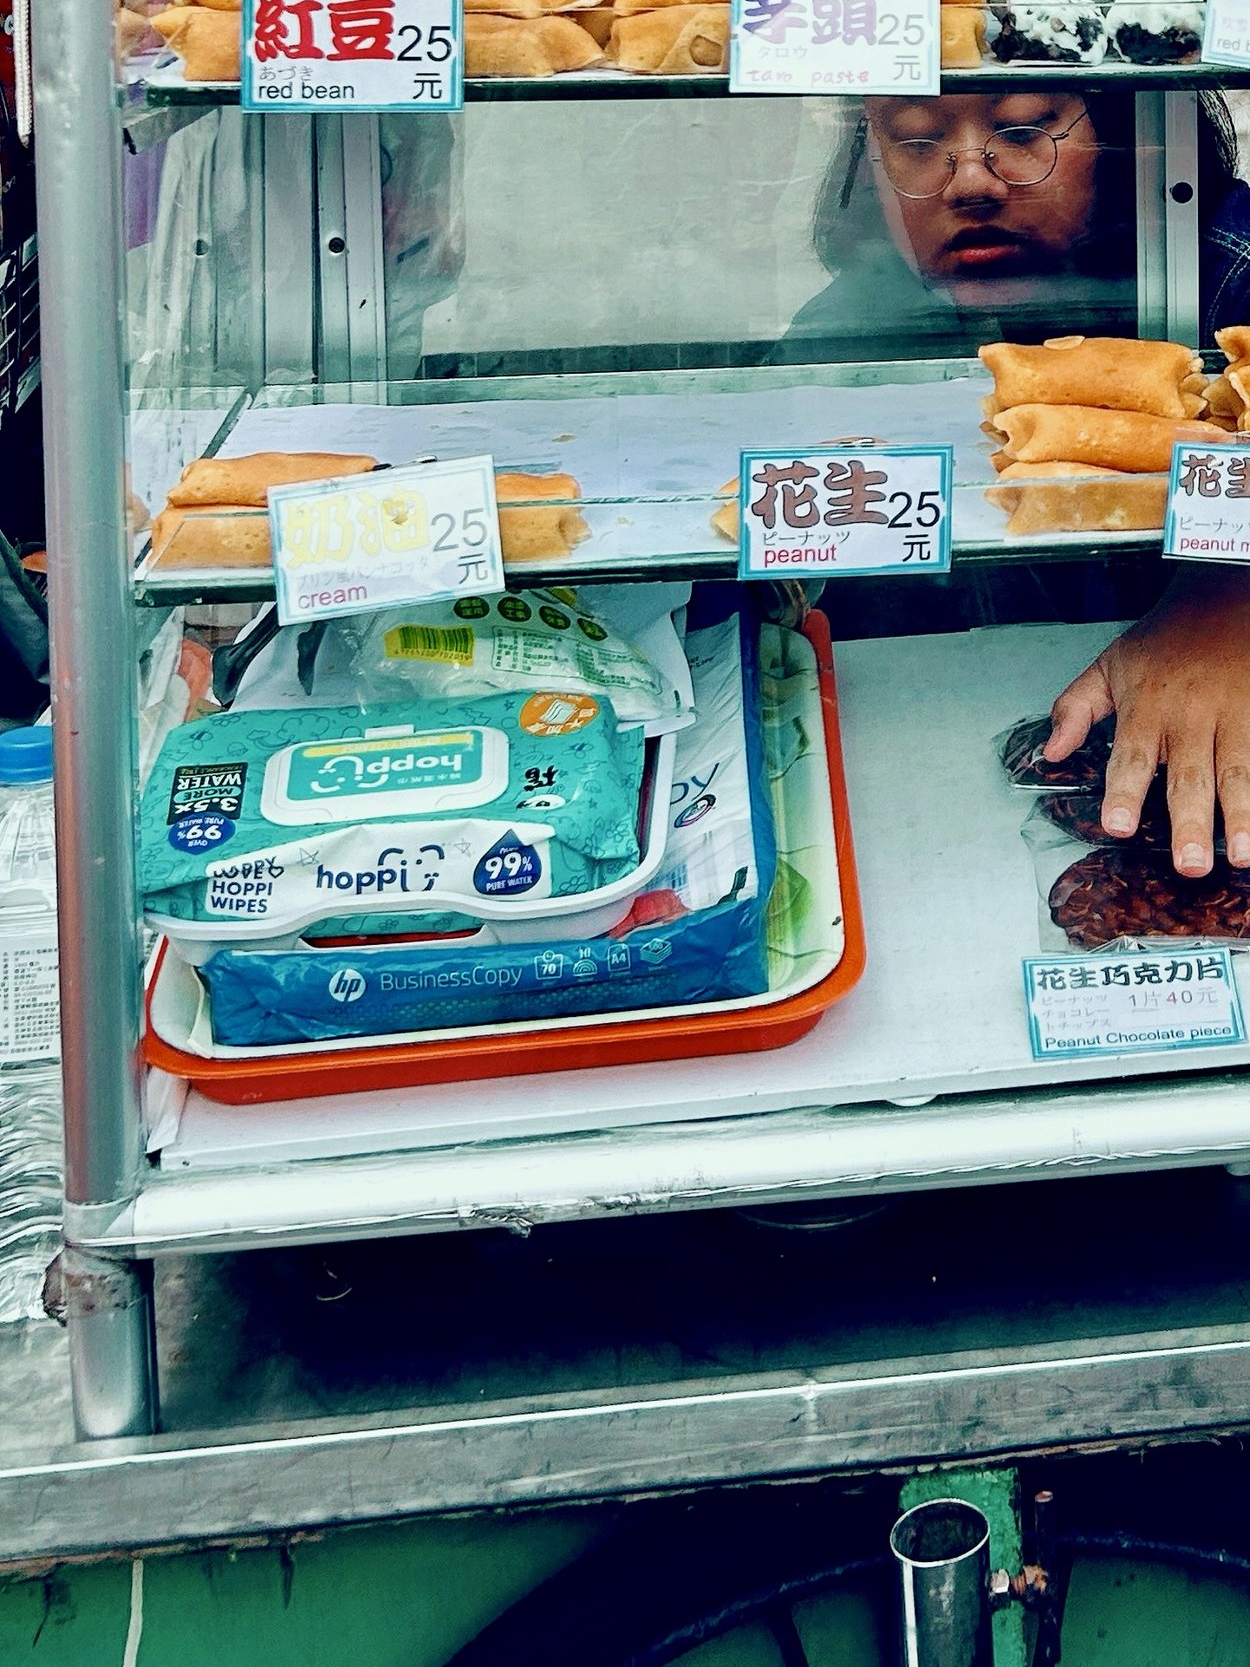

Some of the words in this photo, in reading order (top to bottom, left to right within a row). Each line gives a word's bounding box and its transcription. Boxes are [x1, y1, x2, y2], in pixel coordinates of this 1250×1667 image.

[878, 13, 925, 45] 25
[396, 25, 452, 62] 25
[1217, 37, 1241, 51] red
[258, 65, 313, 82] あづき
[747, 70, 792, 83] taro
[811, 70, 870, 87] paste
[893, 55, 921, 81] 元
[258, 82, 293, 99] red
[302, 81, 355, 99] bean
[412, 73, 443, 100] 元
[752, 460, 889, 529] 花生
[887, 491, 941, 528] 25
[285, 485, 430, 569] 奶油
[431, 508, 488, 552] 25
[763, 531, 850, 547] ピーナッツ
[764, 544, 838, 567] peanut
[902, 534, 930, 562] 元
[1180, 536, 1235, 552] peanut
[457, 553, 488, 585] 元
[298, 585, 367, 609] cream
[340, 752, 462, 784] hoppi
[177, 772, 241, 790] WATER
[183, 787, 234, 801] MORE
[316, 855, 418, 895] hoppi
[484, 852, 533, 880] 99%
[212, 880, 272, 896] HOPPI
[486, 879, 505, 892] PURE
[507, 875, 533, 887] WATER
[211, 895, 267, 913] WIPES
[541, 964, 556, 975] 70
[611, 954, 626, 965] A4
[380, 964, 523, 991] BusinessCopy
[1037, 956, 1224, 991] 花生巧克力片
[333, 970, 364, 1003] hp
[1045, 1036, 1101, 1049] Peanut
[1106, 1028, 1185, 1044] Chocolate
[1190, 1025, 1232, 1041] piece
